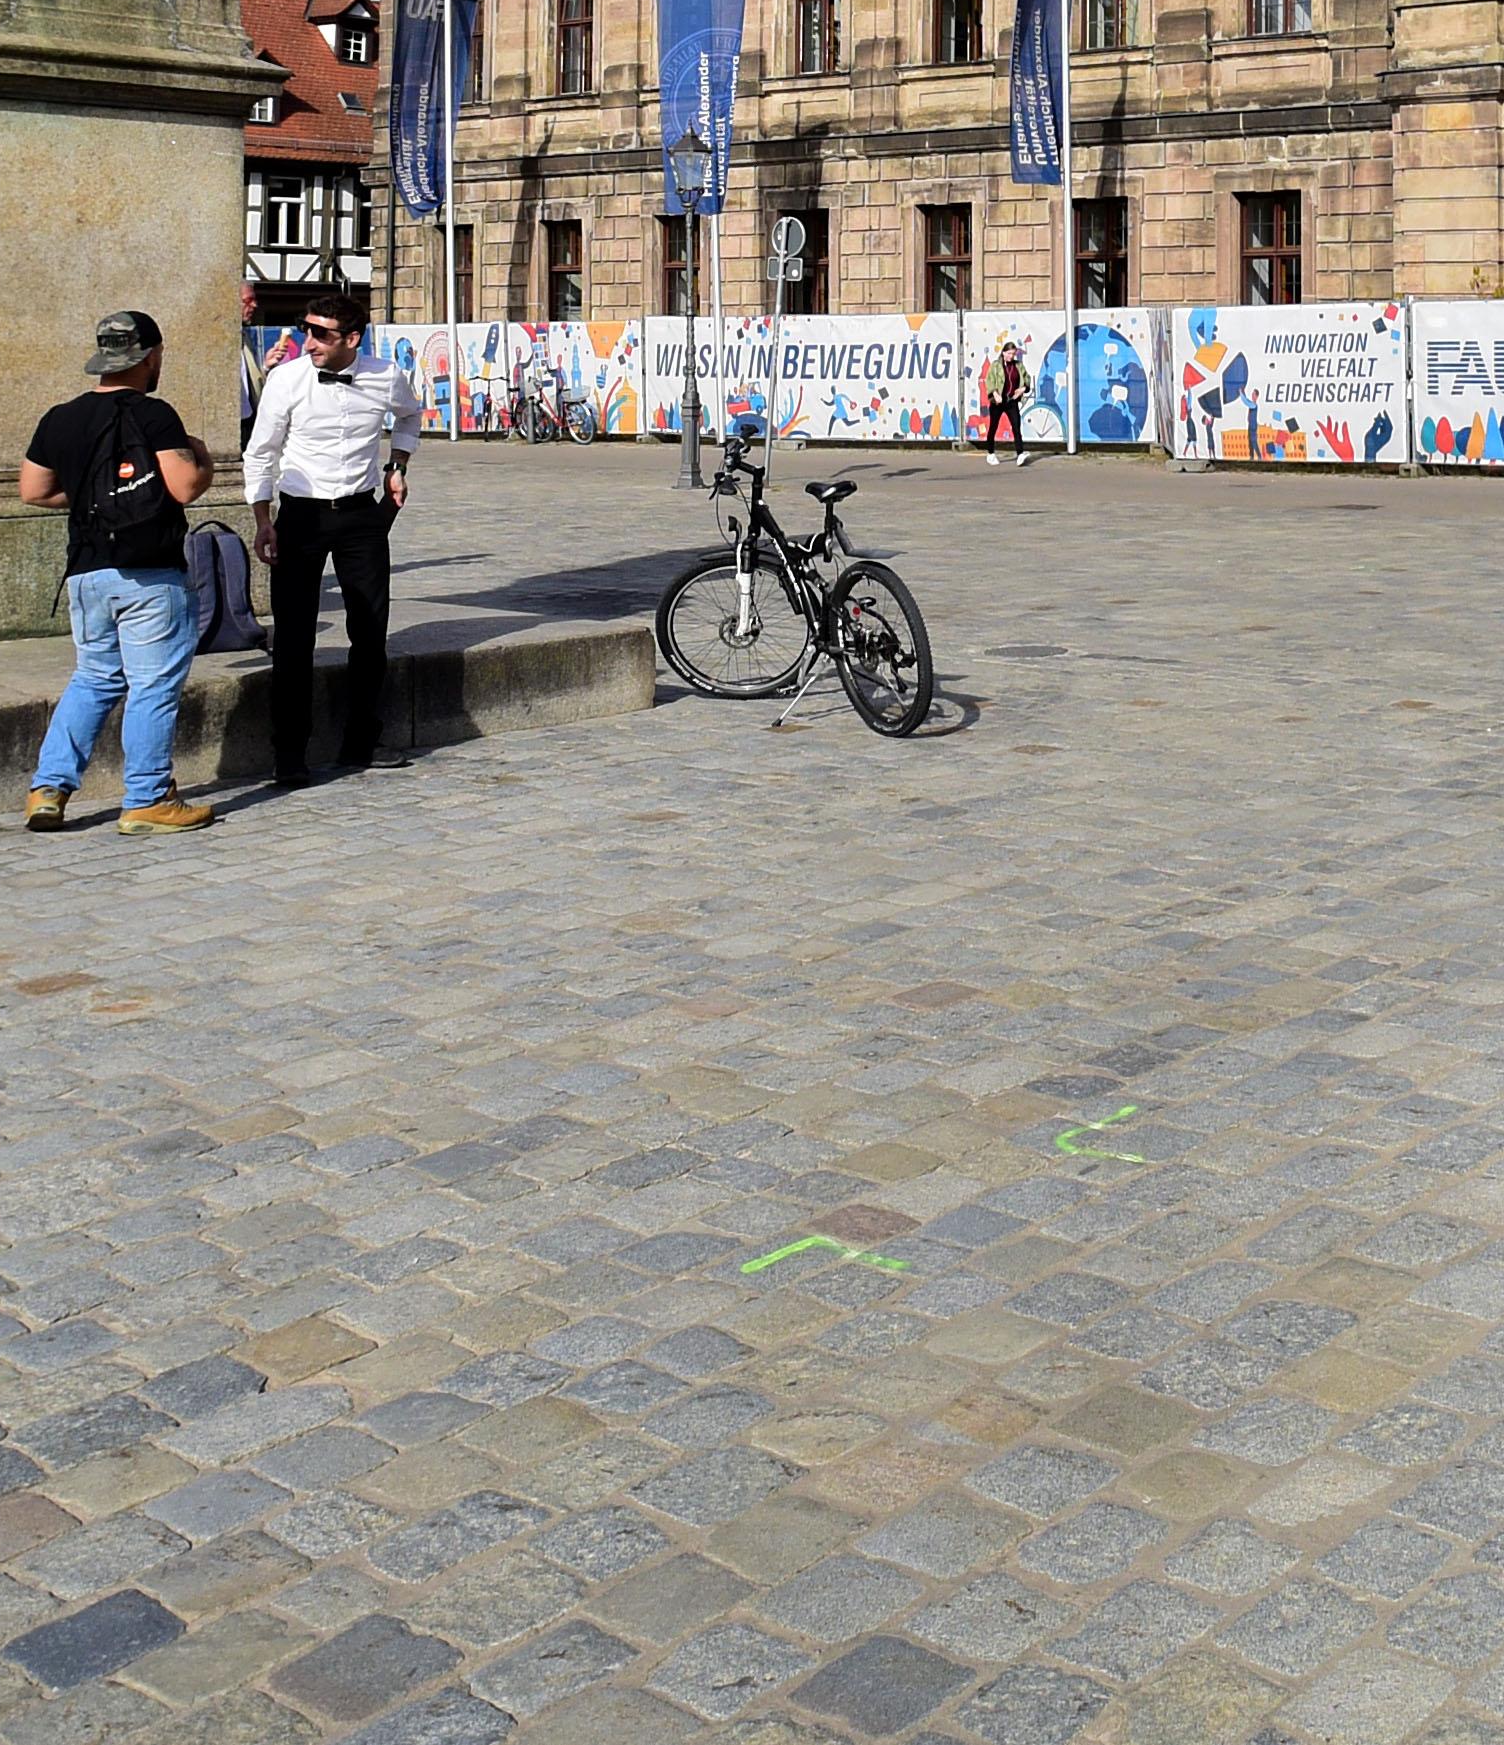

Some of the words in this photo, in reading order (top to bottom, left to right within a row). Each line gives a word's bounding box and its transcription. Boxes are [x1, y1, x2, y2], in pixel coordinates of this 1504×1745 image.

[1264, 333, 1368, 354] INNOVATION
[655, 343, 742, 379] WISN
[748, 344, 775, 379] IN
[782, 342, 953, 380] BEWEGUNG
[1300, 357, 1378, 378] VIELFALT
[1264, 382, 1395, 403] LEIDENSCHAFT
